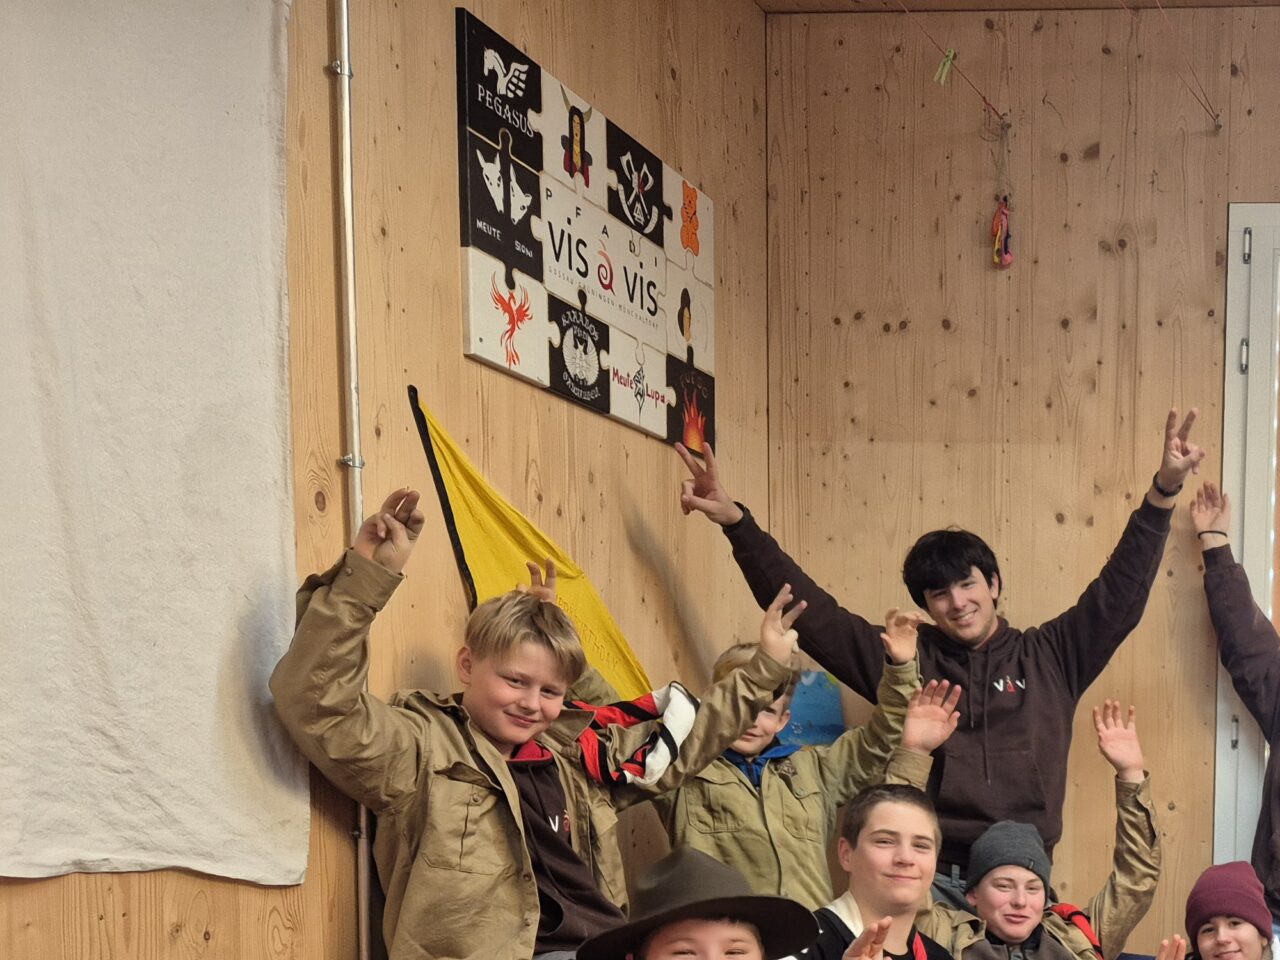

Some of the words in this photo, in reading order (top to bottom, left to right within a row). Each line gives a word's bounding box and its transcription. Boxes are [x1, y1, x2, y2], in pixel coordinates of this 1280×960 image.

[477, 83, 534, 138] PEGASUS
[476, 218, 501, 242] MEUTE
[645, 382, 666, 408] Lupa
